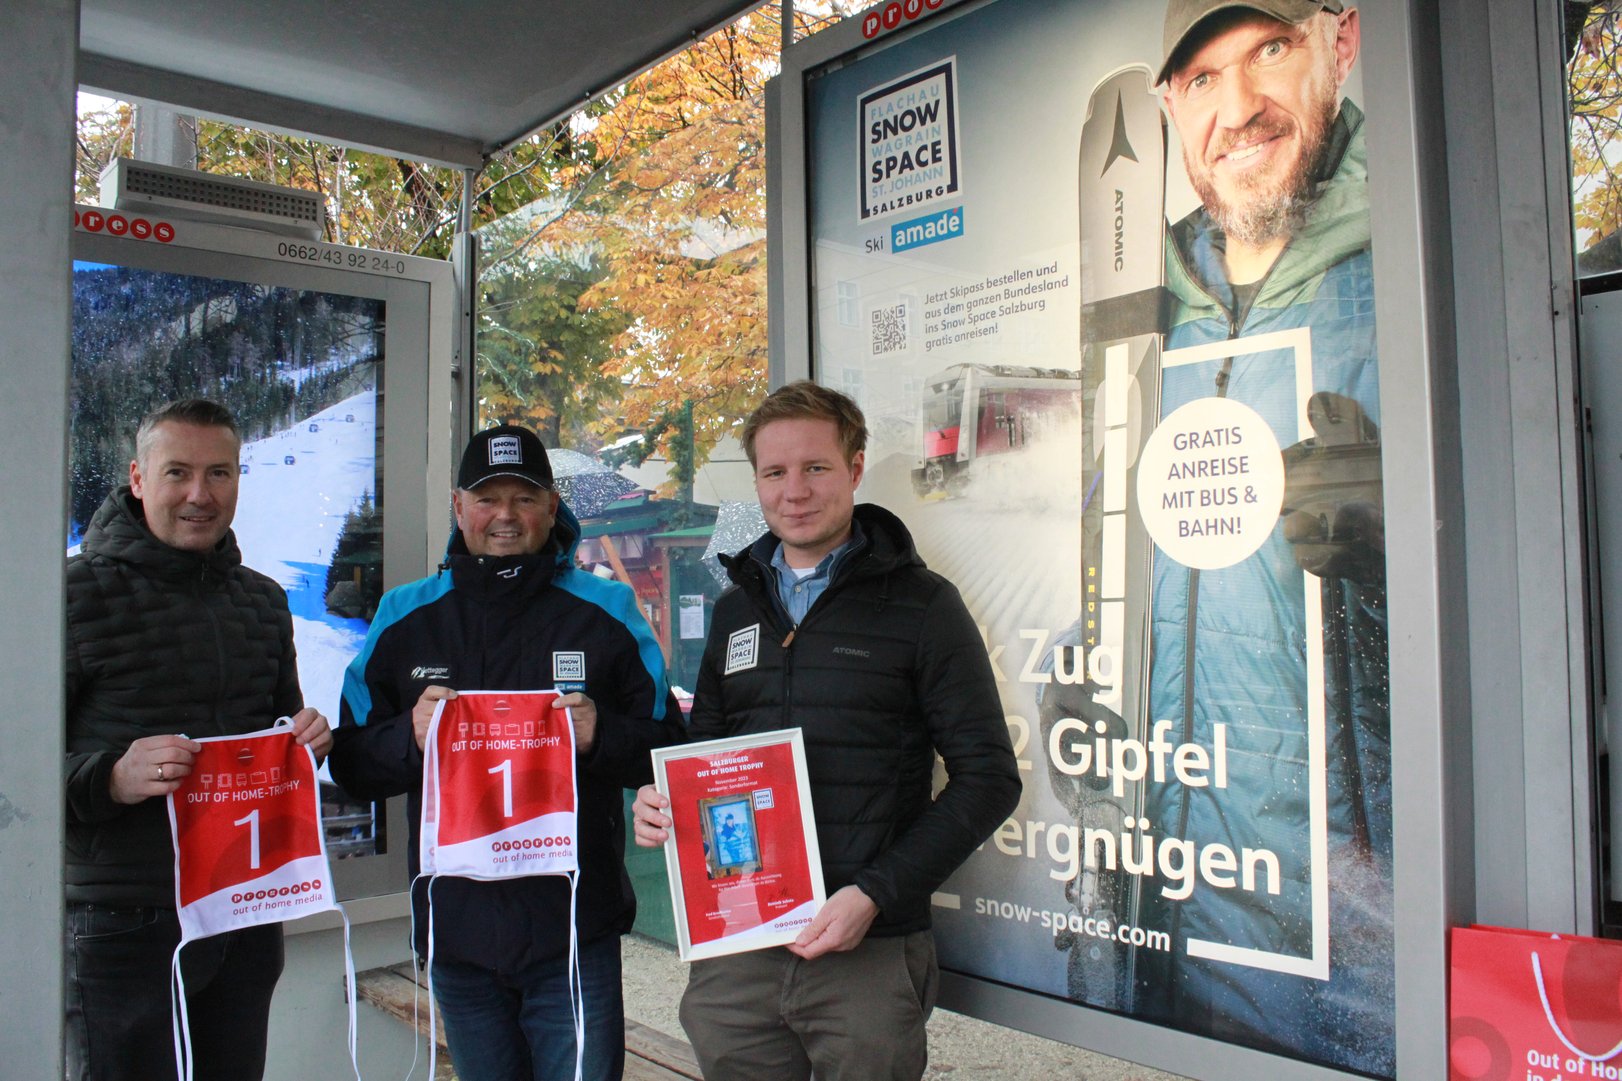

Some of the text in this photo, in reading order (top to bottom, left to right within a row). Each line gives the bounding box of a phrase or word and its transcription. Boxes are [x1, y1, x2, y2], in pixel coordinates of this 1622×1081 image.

[871, 84, 939, 120] FLACHAU
[871, 99, 940, 144] SNOW
[872, 125, 941, 158] WAGRAIN
[872, 140, 942, 183] SPACE
[872, 166, 944, 199] ST. JOHANN
[872, 186, 944, 216] SALZBURG
[865, 236, 884, 253] Ski
[1114, 189, 1124, 272] ATOMIC
[278, 242, 405, 274] 0662/43 92 24-0
[925, 261, 1058, 305] Jetzt Skipass bestellen und
[925, 275, 1069, 319] aus dem ganzen Bundesland
[925, 299, 1046, 334] ins Snow Space Salzburg
[925, 322, 998, 352] gratis anreisen!
[1174, 426, 1242, 451] GRATIS
[1167, 456, 1250, 481] ANREISE
[1162, 485, 1258, 510] MIT BUS &
[1178, 517, 1241, 538] BAHN!
[731, 649, 751, 660] SPACE
[732, 638, 752, 649] SNOW
[832, 646, 871, 657] ATOMIC
[1018, 628, 1124, 702] Zug
[452, 736, 560, 752] OUT OF HOME-TROPHY
[1005, 715, 1228, 797] 2 Gipfel
[697, 770, 710, 778] OUT
[739, 762, 764, 772] TROPHY
[710, 755, 749, 767] SALZBURGER
[188, 780, 300, 803] OUT OF HOME-TROPHY
[488, 759, 513, 817] 1
[234, 809, 260, 869] 1
[492, 849, 573, 865] out of home media
[977, 815, 1281, 900] ergnügen
[233, 893, 323, 916] out of home media
[975, 897, 1171, 951] snow-space.com
[1527, 1049, 1622, 1081] Out of Ho
